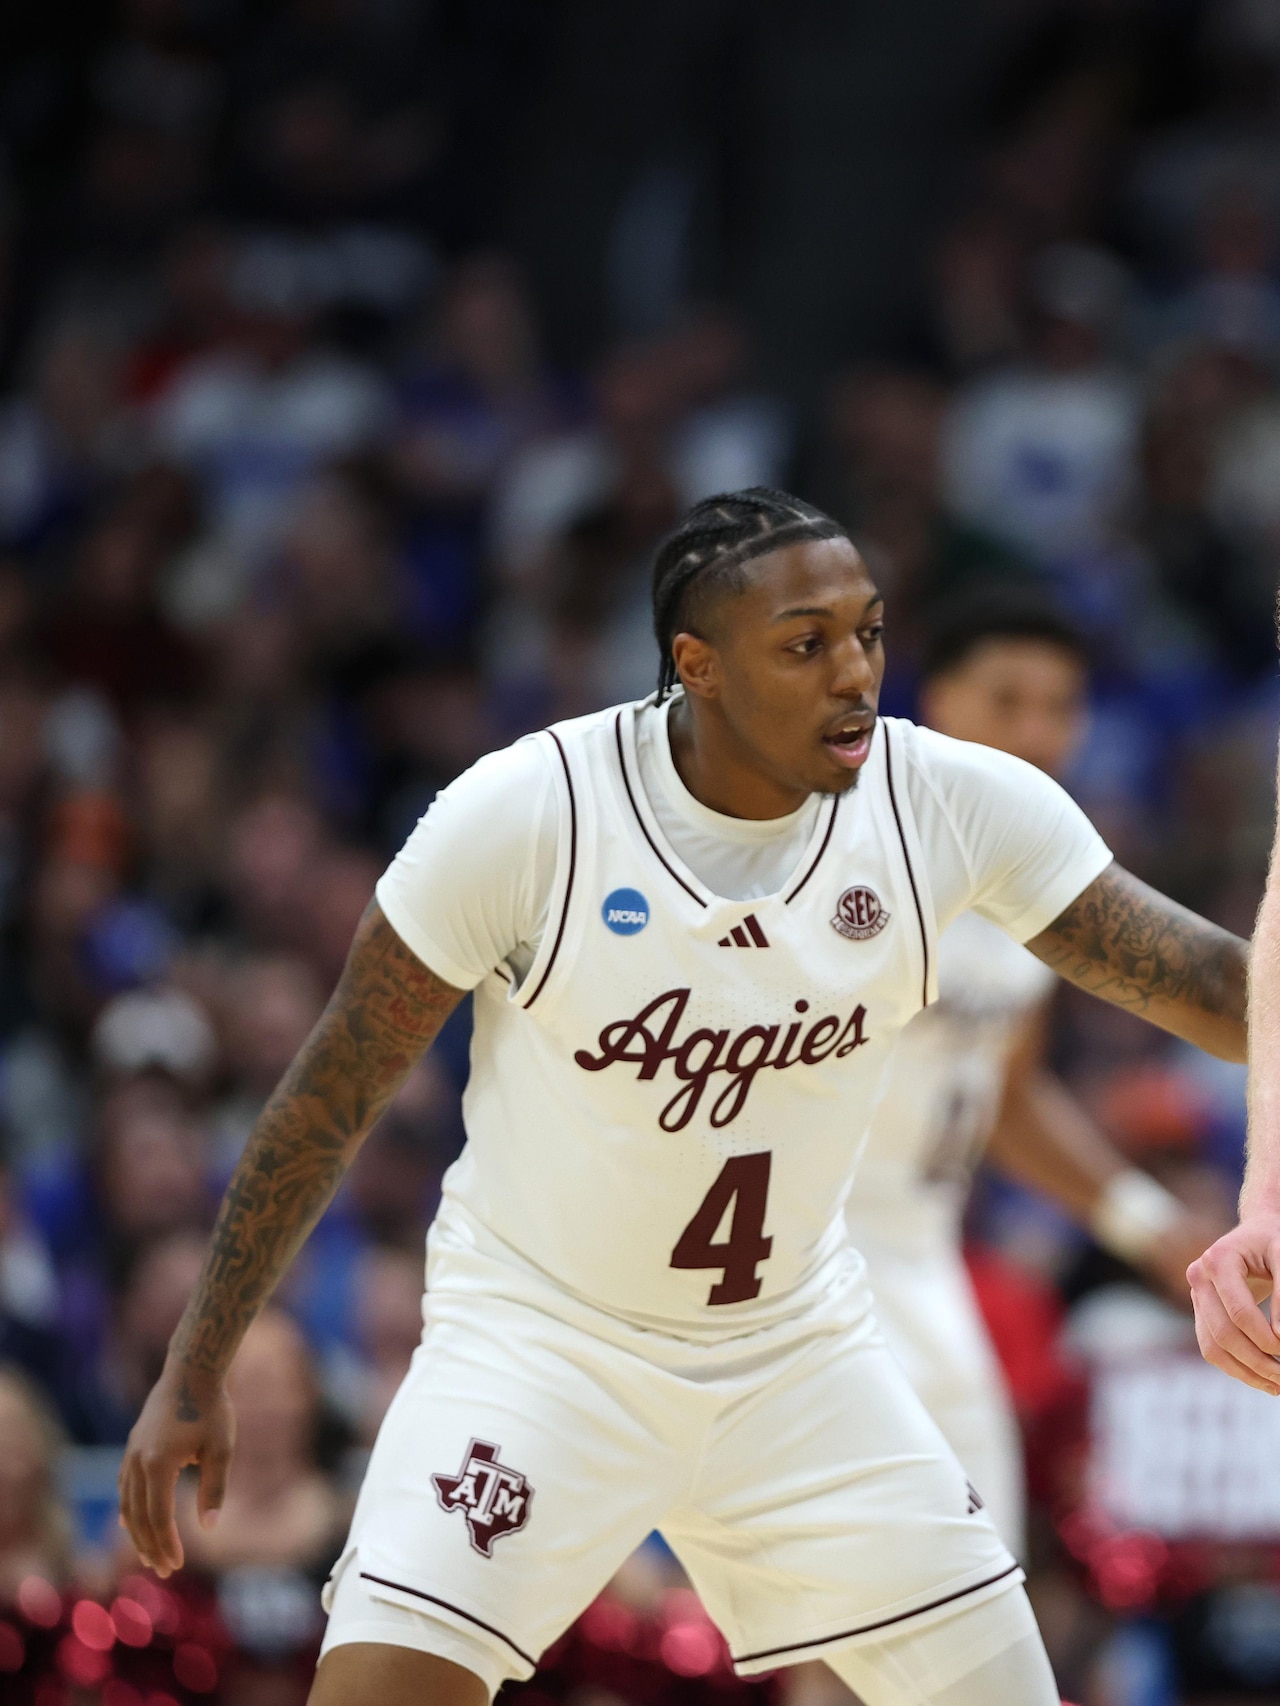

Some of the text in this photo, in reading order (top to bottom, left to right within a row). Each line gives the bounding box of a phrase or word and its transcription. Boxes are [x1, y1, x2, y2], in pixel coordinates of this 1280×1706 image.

[607, 909, 647, 924] NCAA
[842, 888, 877, 926] SEC
[574, 988, 869, 1132] Aggies
[669, 1150, 773, 1306] 4
